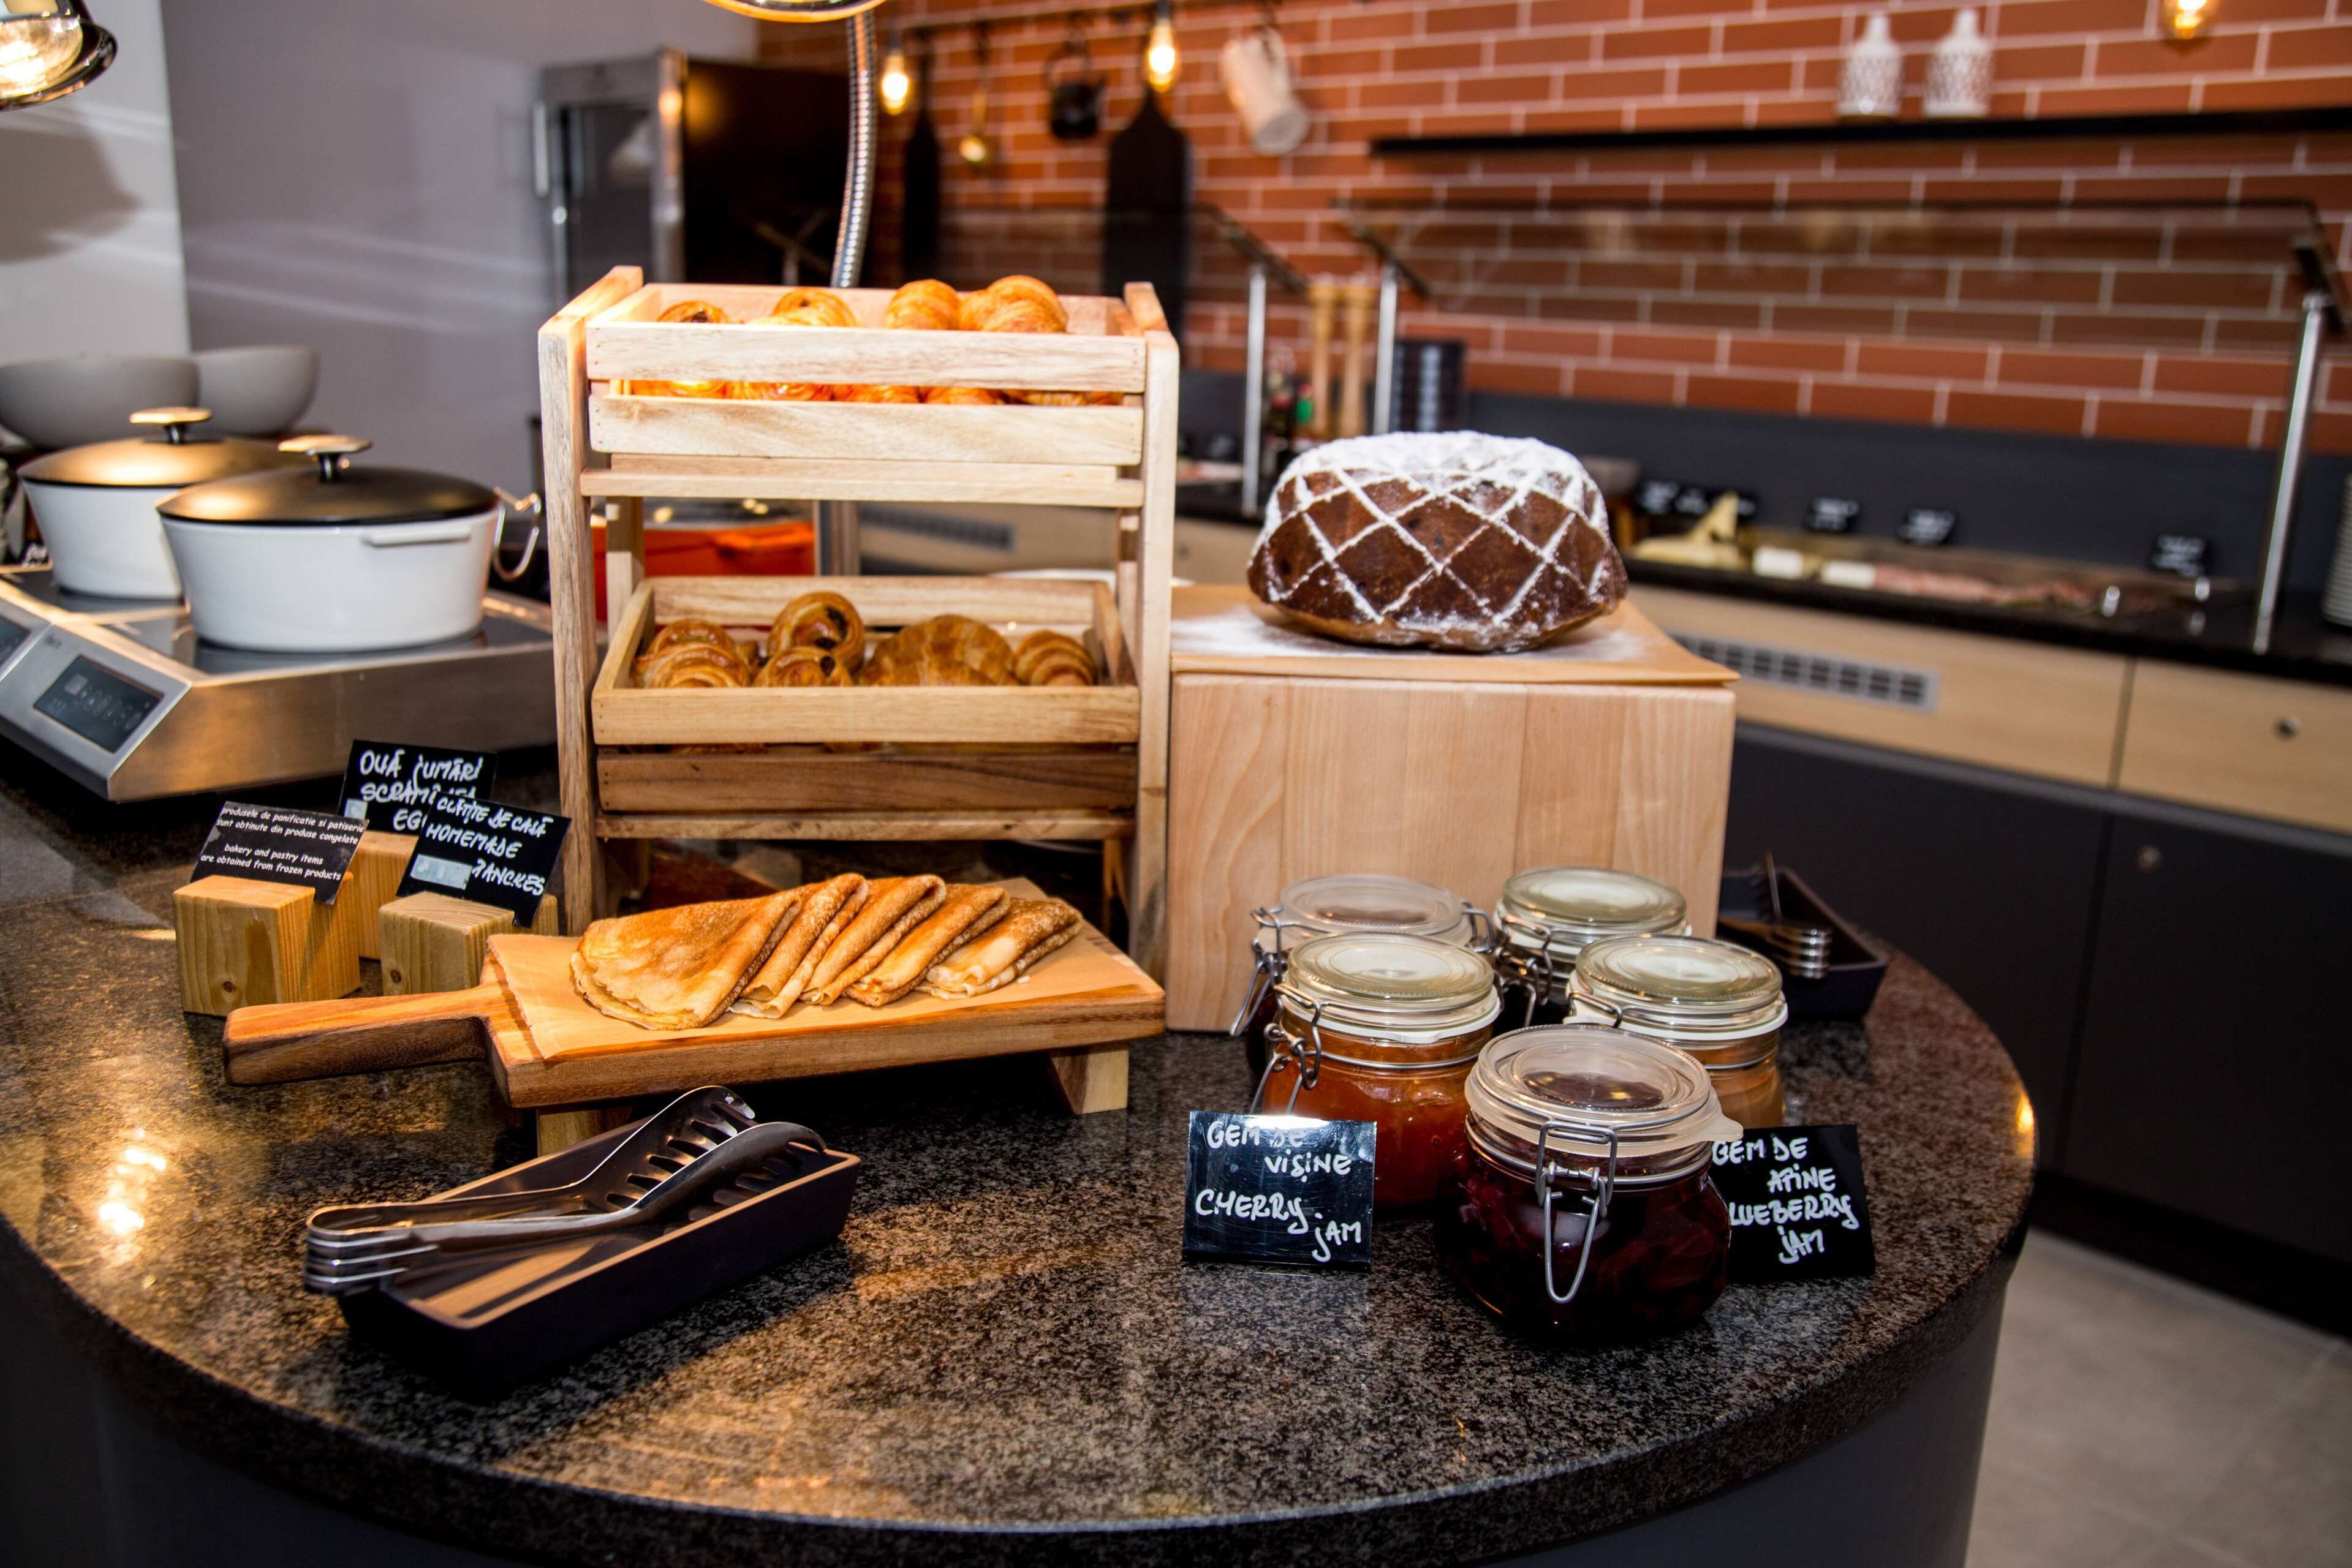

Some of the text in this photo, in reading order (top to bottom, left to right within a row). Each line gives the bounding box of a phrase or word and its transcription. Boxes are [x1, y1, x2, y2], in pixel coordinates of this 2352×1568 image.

[221, 807, 258, 818] produsele
[260, 811, 271, 820] de
[273, 813, 315, 826] panificatie
[327, 820, 366, 833] patiserie
[235, 820, 268, 832] obtinute
[271, 826, 283, 834] din
[284, 829, 317, 840] produse
[319, 833, 358, 845] congelate
[224, 843, 323, 865] bakery and pastry items
[425, 823, 523, 859] HOMEMADE
[216, 856, 251, 868] obtained
[253, 860, 274, 871] from
[276, 864, 303, 876] frozen
[304, 869, 342, 881] products
[1207, 1120, 1262, 1149] GEM
[1712, 1134, 1808, 1166] GEM DE
[1195, 1189, 1309, 1235] CHERRY
[1728, 1193, 1860, 1230] LUEBERRY
